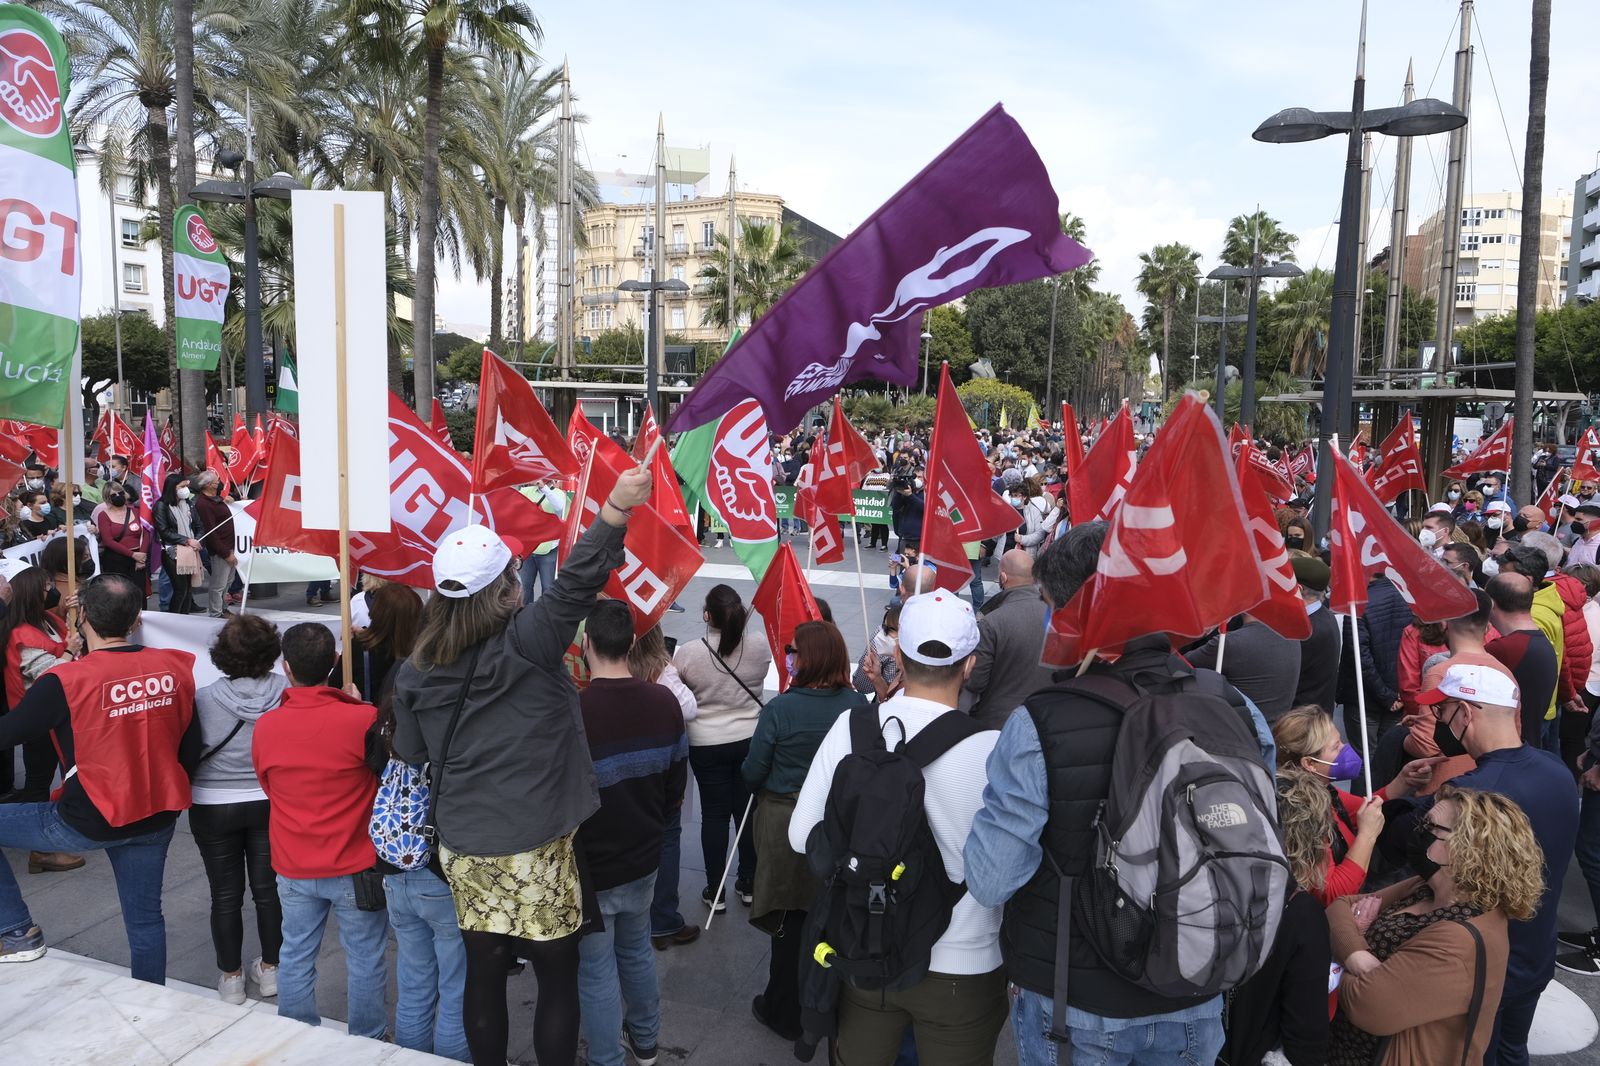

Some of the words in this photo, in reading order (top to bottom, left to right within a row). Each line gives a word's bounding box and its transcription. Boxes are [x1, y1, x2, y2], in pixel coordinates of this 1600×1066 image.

[0, 198, 78, 276] GT
[178, 273, 227, 305] UGT
[0, 352, 62, 382] lucía
[855, 507, 883, 518] aluza
[109, 696, 173, 718] andalucía
[1197, 810, 1230, 823] NORTH
[1209, 803, 1228, 814] THE
[1208, 820, 1232, 829] FACE
